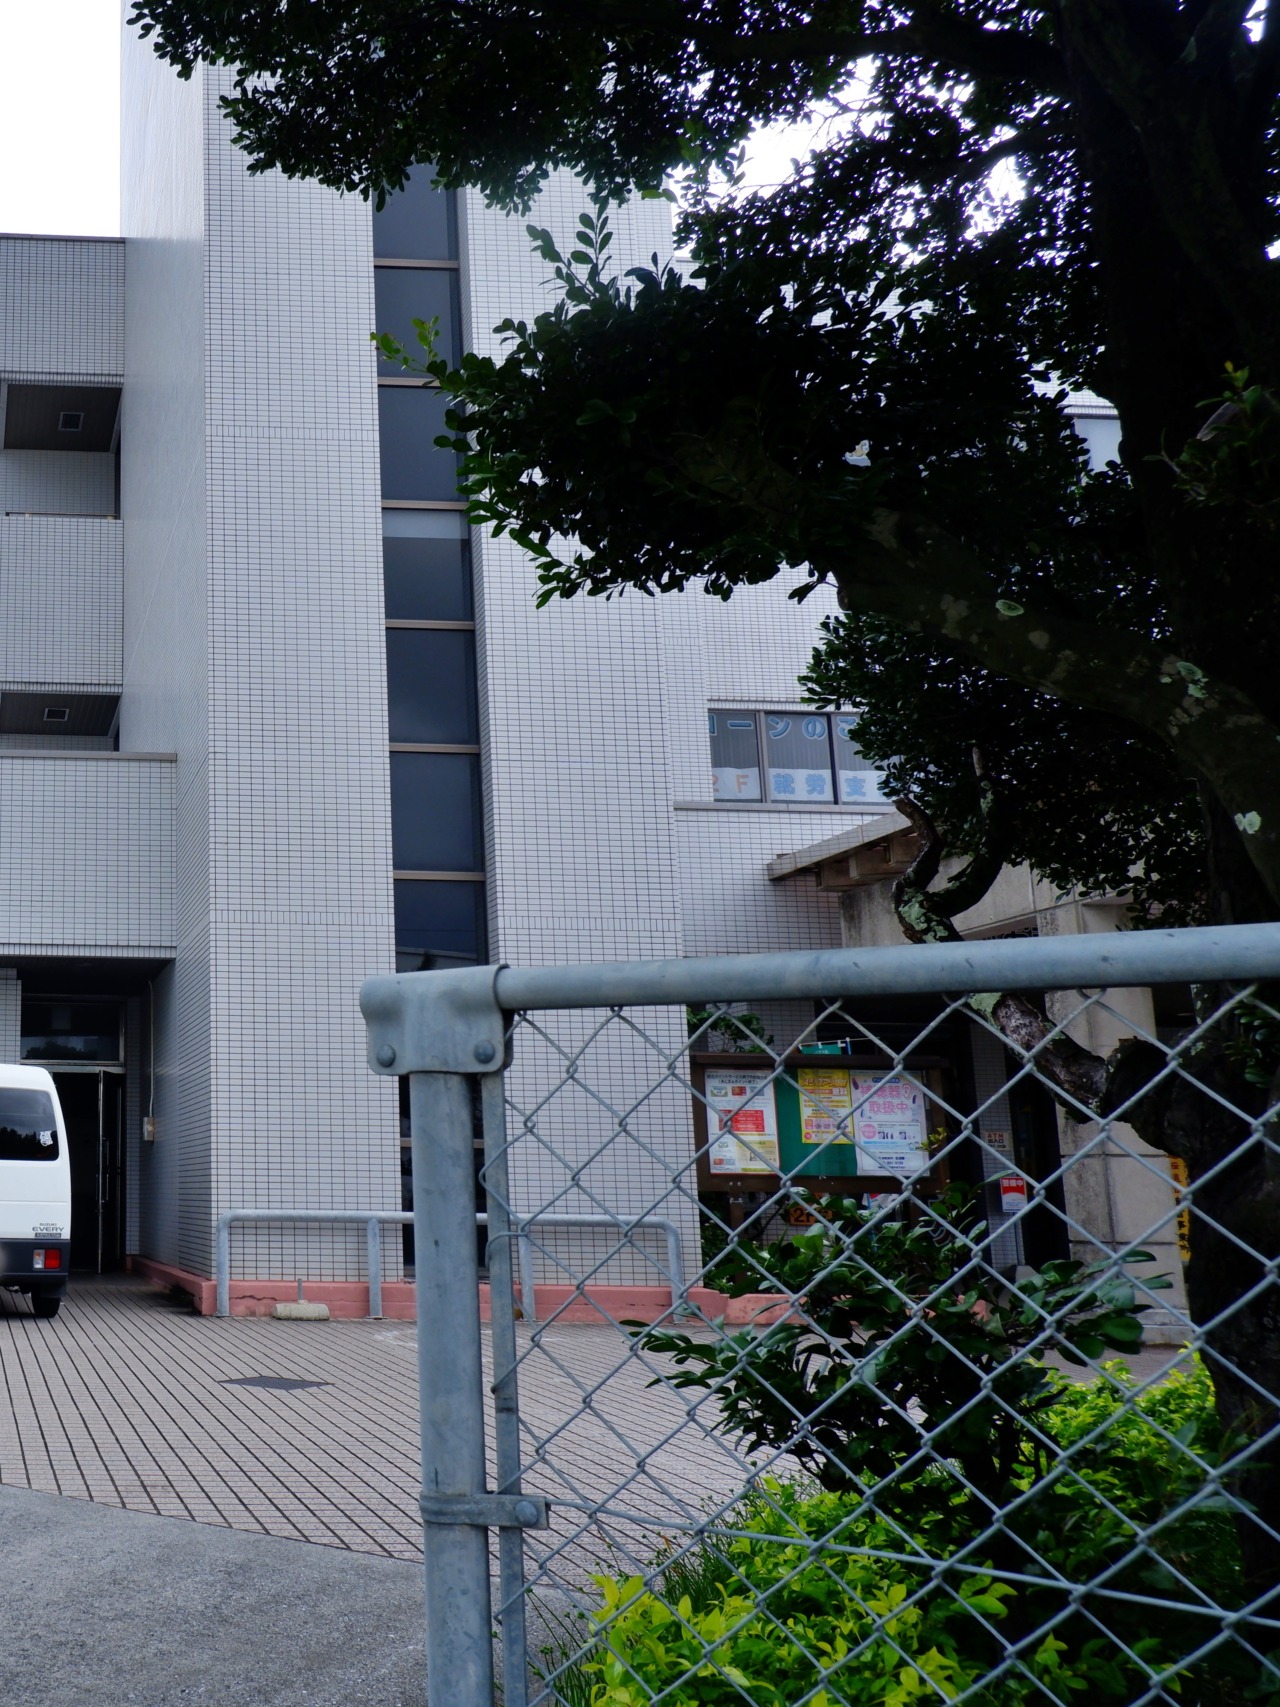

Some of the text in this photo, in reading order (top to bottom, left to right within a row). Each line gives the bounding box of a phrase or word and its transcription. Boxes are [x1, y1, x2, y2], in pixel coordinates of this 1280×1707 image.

[773, 773, 885, 800] 就労支
[868, 1100, 909, 1115] 取扱中
